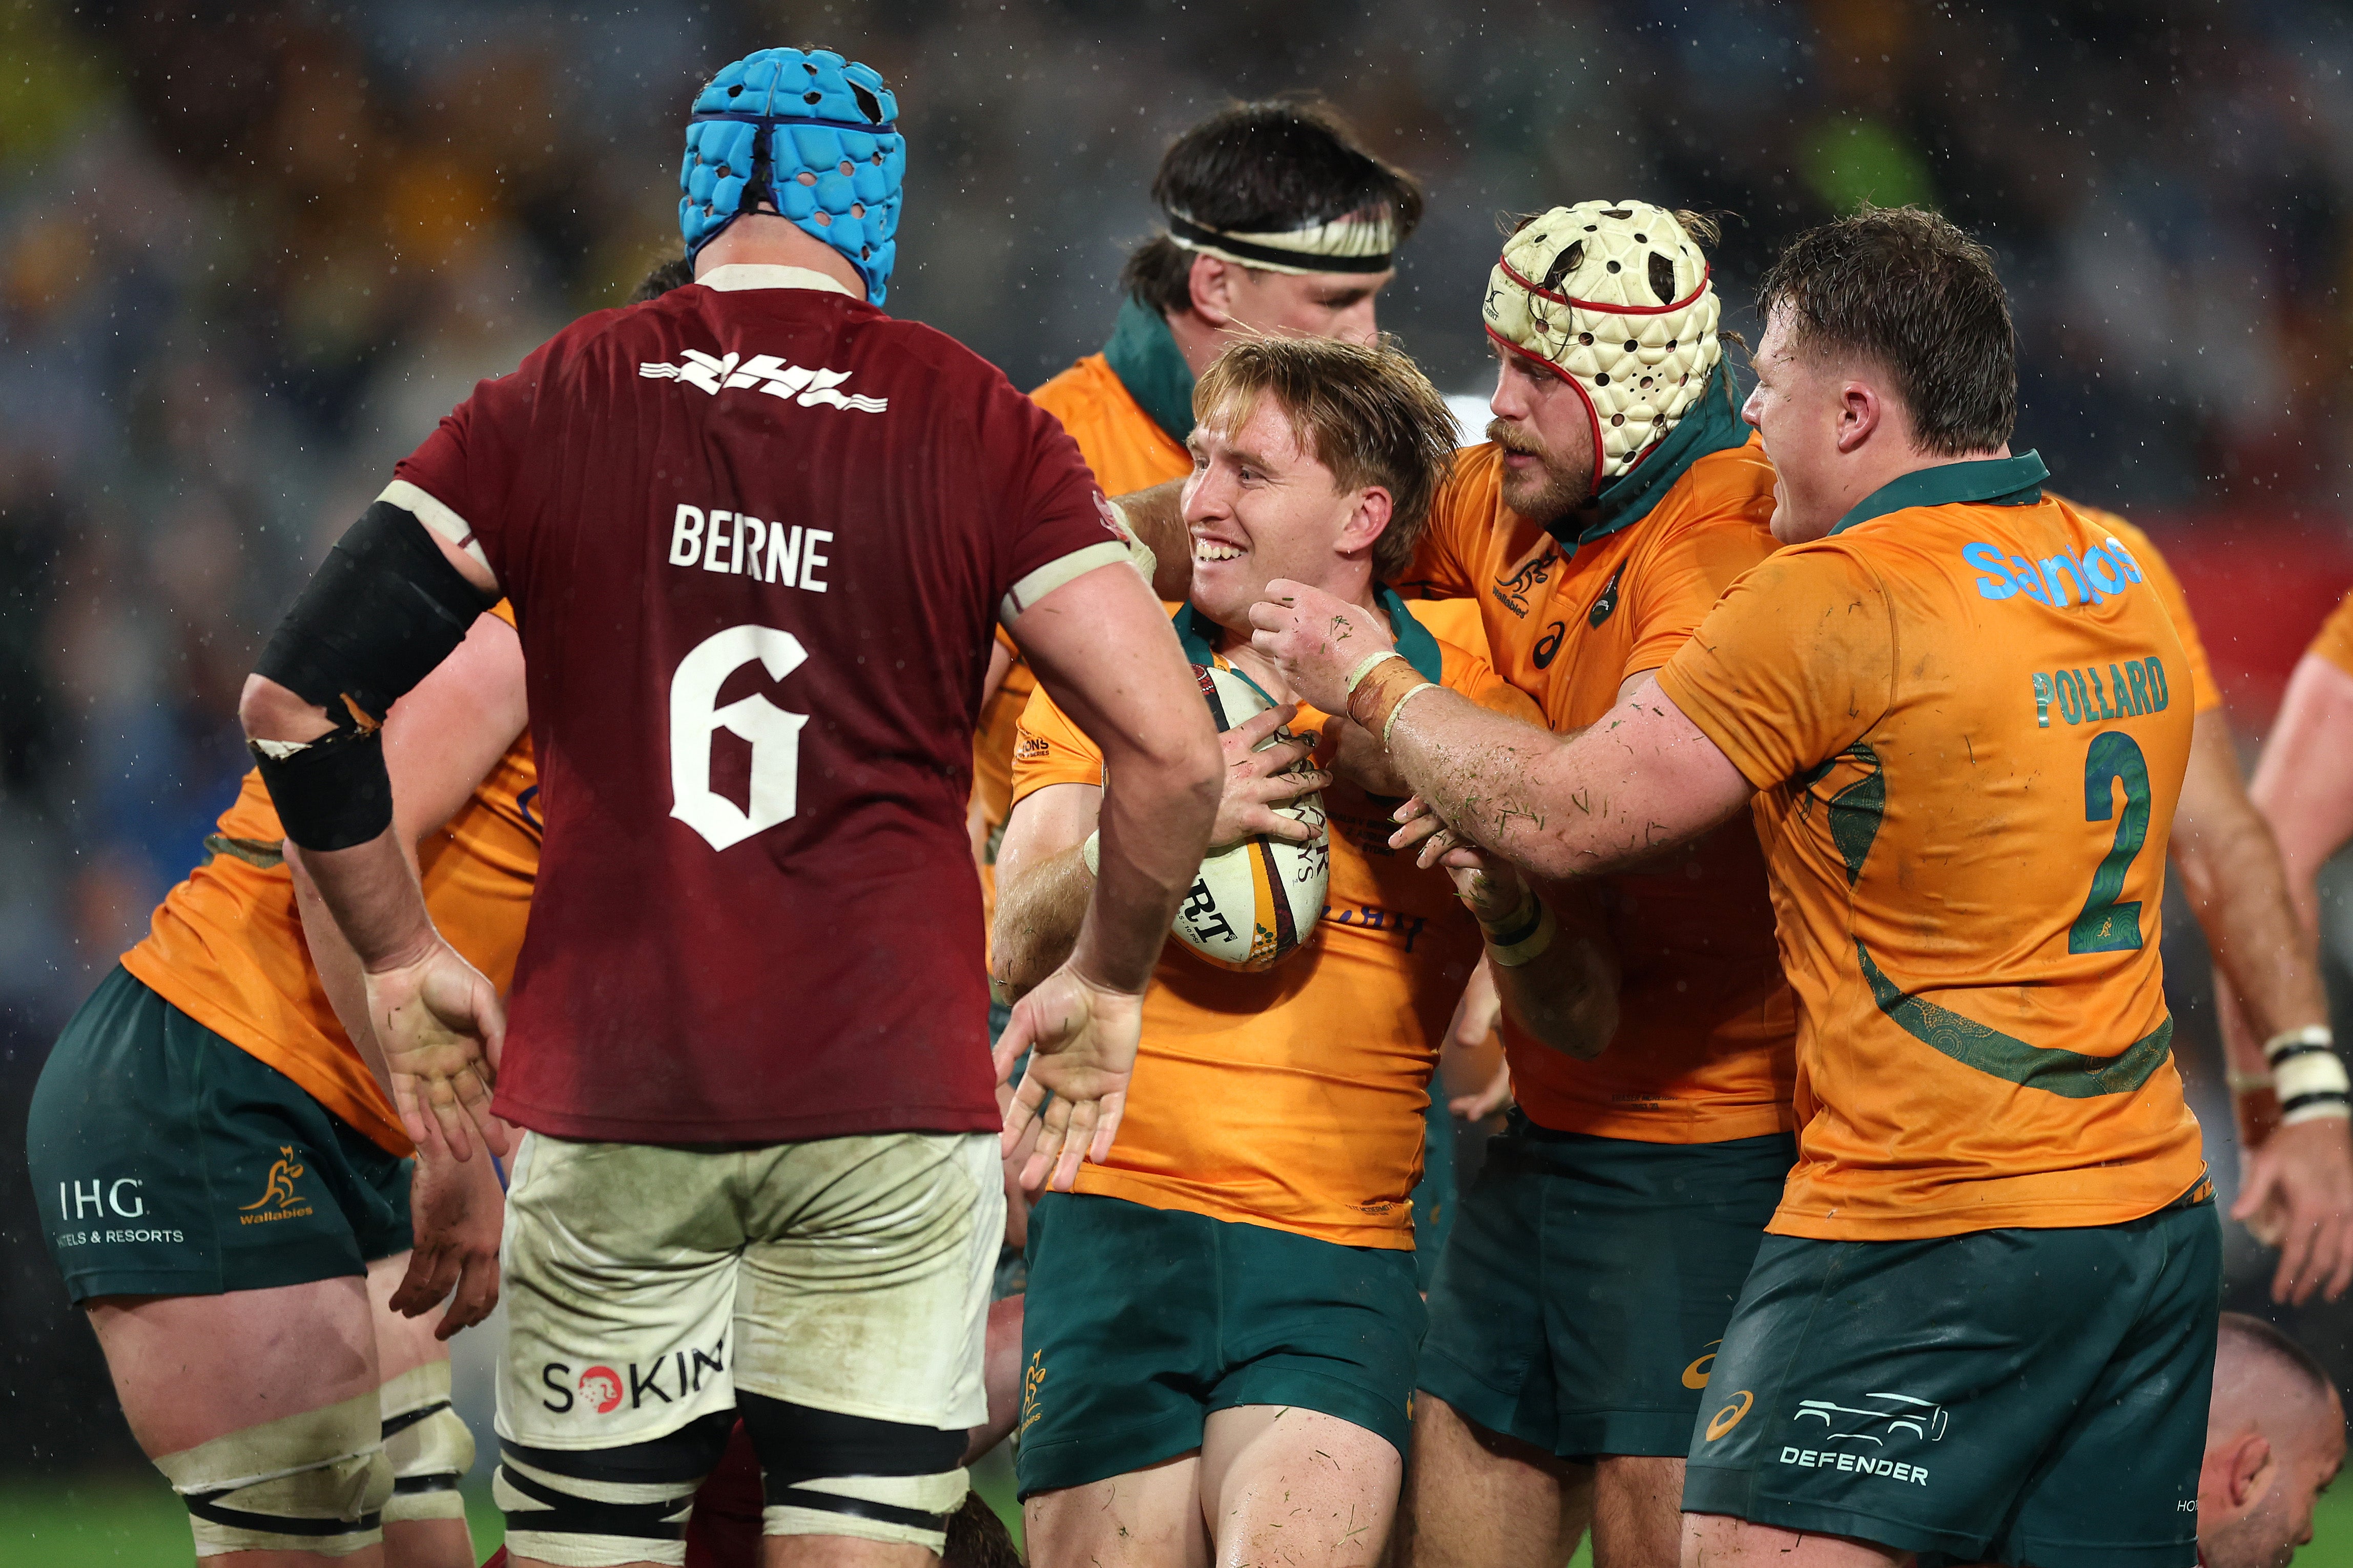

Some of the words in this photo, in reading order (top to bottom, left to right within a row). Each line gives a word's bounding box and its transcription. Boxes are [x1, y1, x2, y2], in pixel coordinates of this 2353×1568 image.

[2032, 656, 2169, 728] POLLARD
[669, 624, 810, 852] 6
[2068, 731, 2152, 955] 2
[60, 1178, 143, 1221] IHG
[240, 1207, 313, 1225] Wallabies
[91, 1230, 101, 1243] &
[106, 1229, 184, 1243] RESORTS
[1780, 1446, 1929, 1487] DEFENDER
